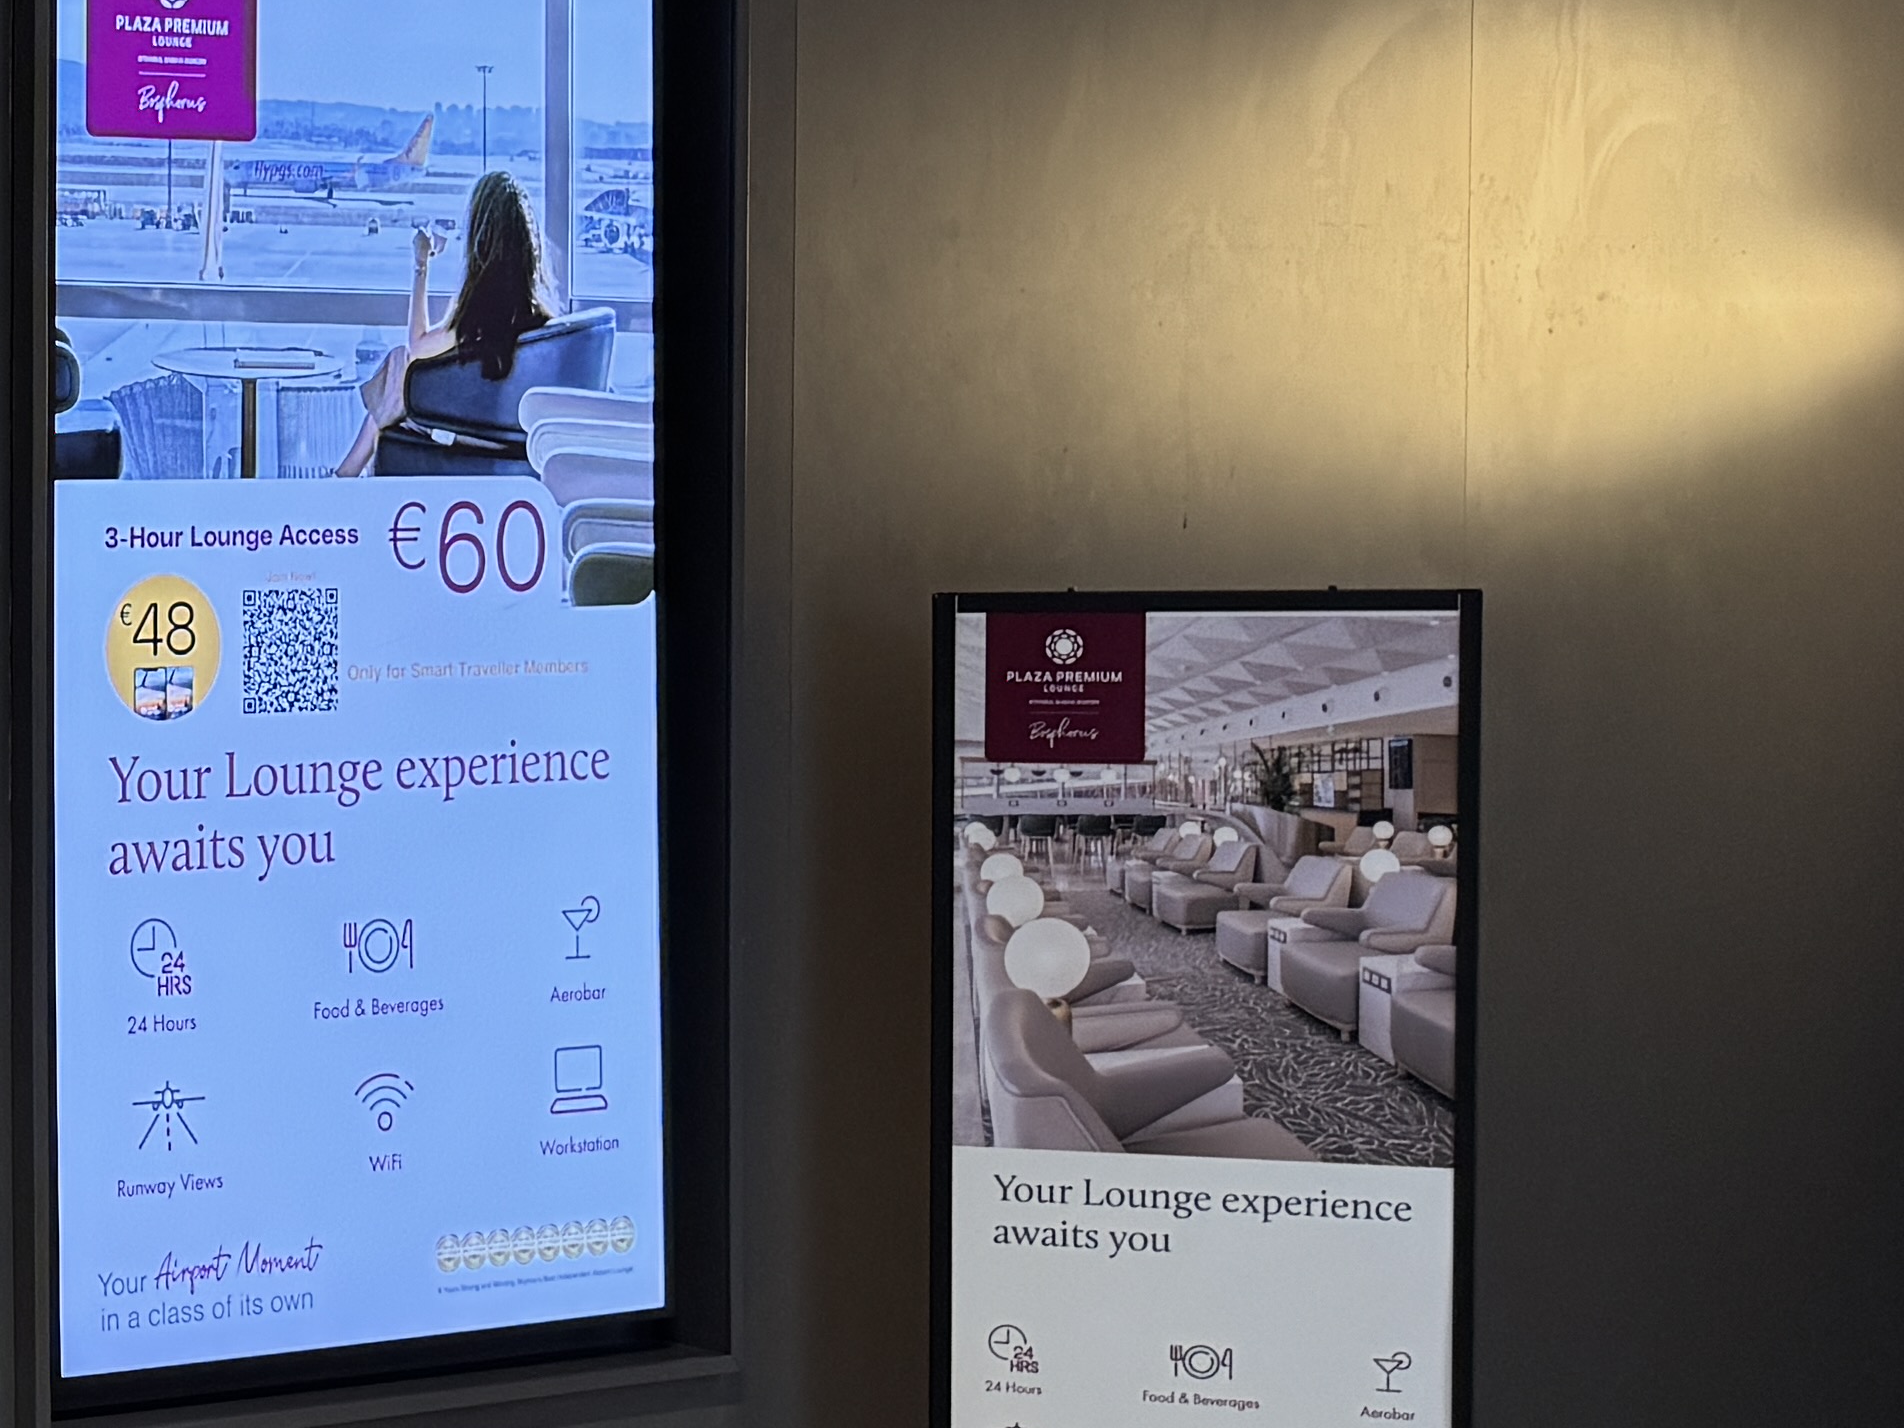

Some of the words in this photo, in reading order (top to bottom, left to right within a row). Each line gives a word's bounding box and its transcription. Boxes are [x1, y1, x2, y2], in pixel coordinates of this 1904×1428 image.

[115, 14, 162, 33] PLAZA
[164, 17, 230, 36] PREMIUM
[152, 35, 193, 48] LOUNGE
[104, 526, 184, 549] 3-Hour
[190, 525, 273, 551] Lounge
[278, 524, 359, 546] Access
[347, 663, 380, 682] Only
[386, 662, 407, 679] for
[410, 661, 453, 679] Smart
[458, 660, 520, 678] Traveller
[524, 658, 589, 675] Members
[1006, 670, 1053, 683] PLAZA
[1055, 670, 1123, 683] PREMIUM
[1043, 683, 1084, 693] LOUNGE
[107, 755, 212, 805] Your
[224, 752, 384, 808] Lounge
[395, 740, 611, 803] experience
[107, 824, 246, 877] awaits
[257, 827, 336, 882] you
[160, 951, 186, 974] 24
[156, 974, 193, 997] HRS
[549, 982, 607, 1003] Aerobar
[313, 998, 350, 1020] Food
[354, 998, 366, 1017] &
[371, 997, 444, 1017] Beverages
[127, 1015, 148, 1035] 24
[152, 1014, 197, 1033] Hours
[539, 1134, 620, 1156] Workstation
[116, 1178, 176, 1200] Runway
[179, 1173, 224, 1191] Views
[993, 1174, 1073, 1205] Your
[1082, 1178, 1212, 1220] Lounge
[1221, 1189, 1413, 1223] experience
[992, 1220, 1100, 1250] awaits
[1107, 1229, 1172, 1259] you
[97, 1272, 147, 1297] Your
[154, 1244, 232, 1295] Airport
[237, 1236, 324, 1275] Moment
[100, 1307, 120, 1332] in
[128, 1310, 141, 1329] a
[148, 1301, 204, 1328] class
[211, 1293, 232, 1320] of
[239, 1292, 264, 1317] its
[270, 1290, 314, 1314] own
[1013, 1345, 1034, 1360] 24
[1009, 1359, 1040, 1374] HRS
[985, 1379, 1002, 1393] 24
[1006, 1381, 1043, 1395] Hours
[1142, 1389, 1175, 1405] Food
[1178, 1392, 1190, 1405] &
[1193, 1392, 1260, 1412] Beverages
[1359, 1405, 1416, 1422] Aerobar
